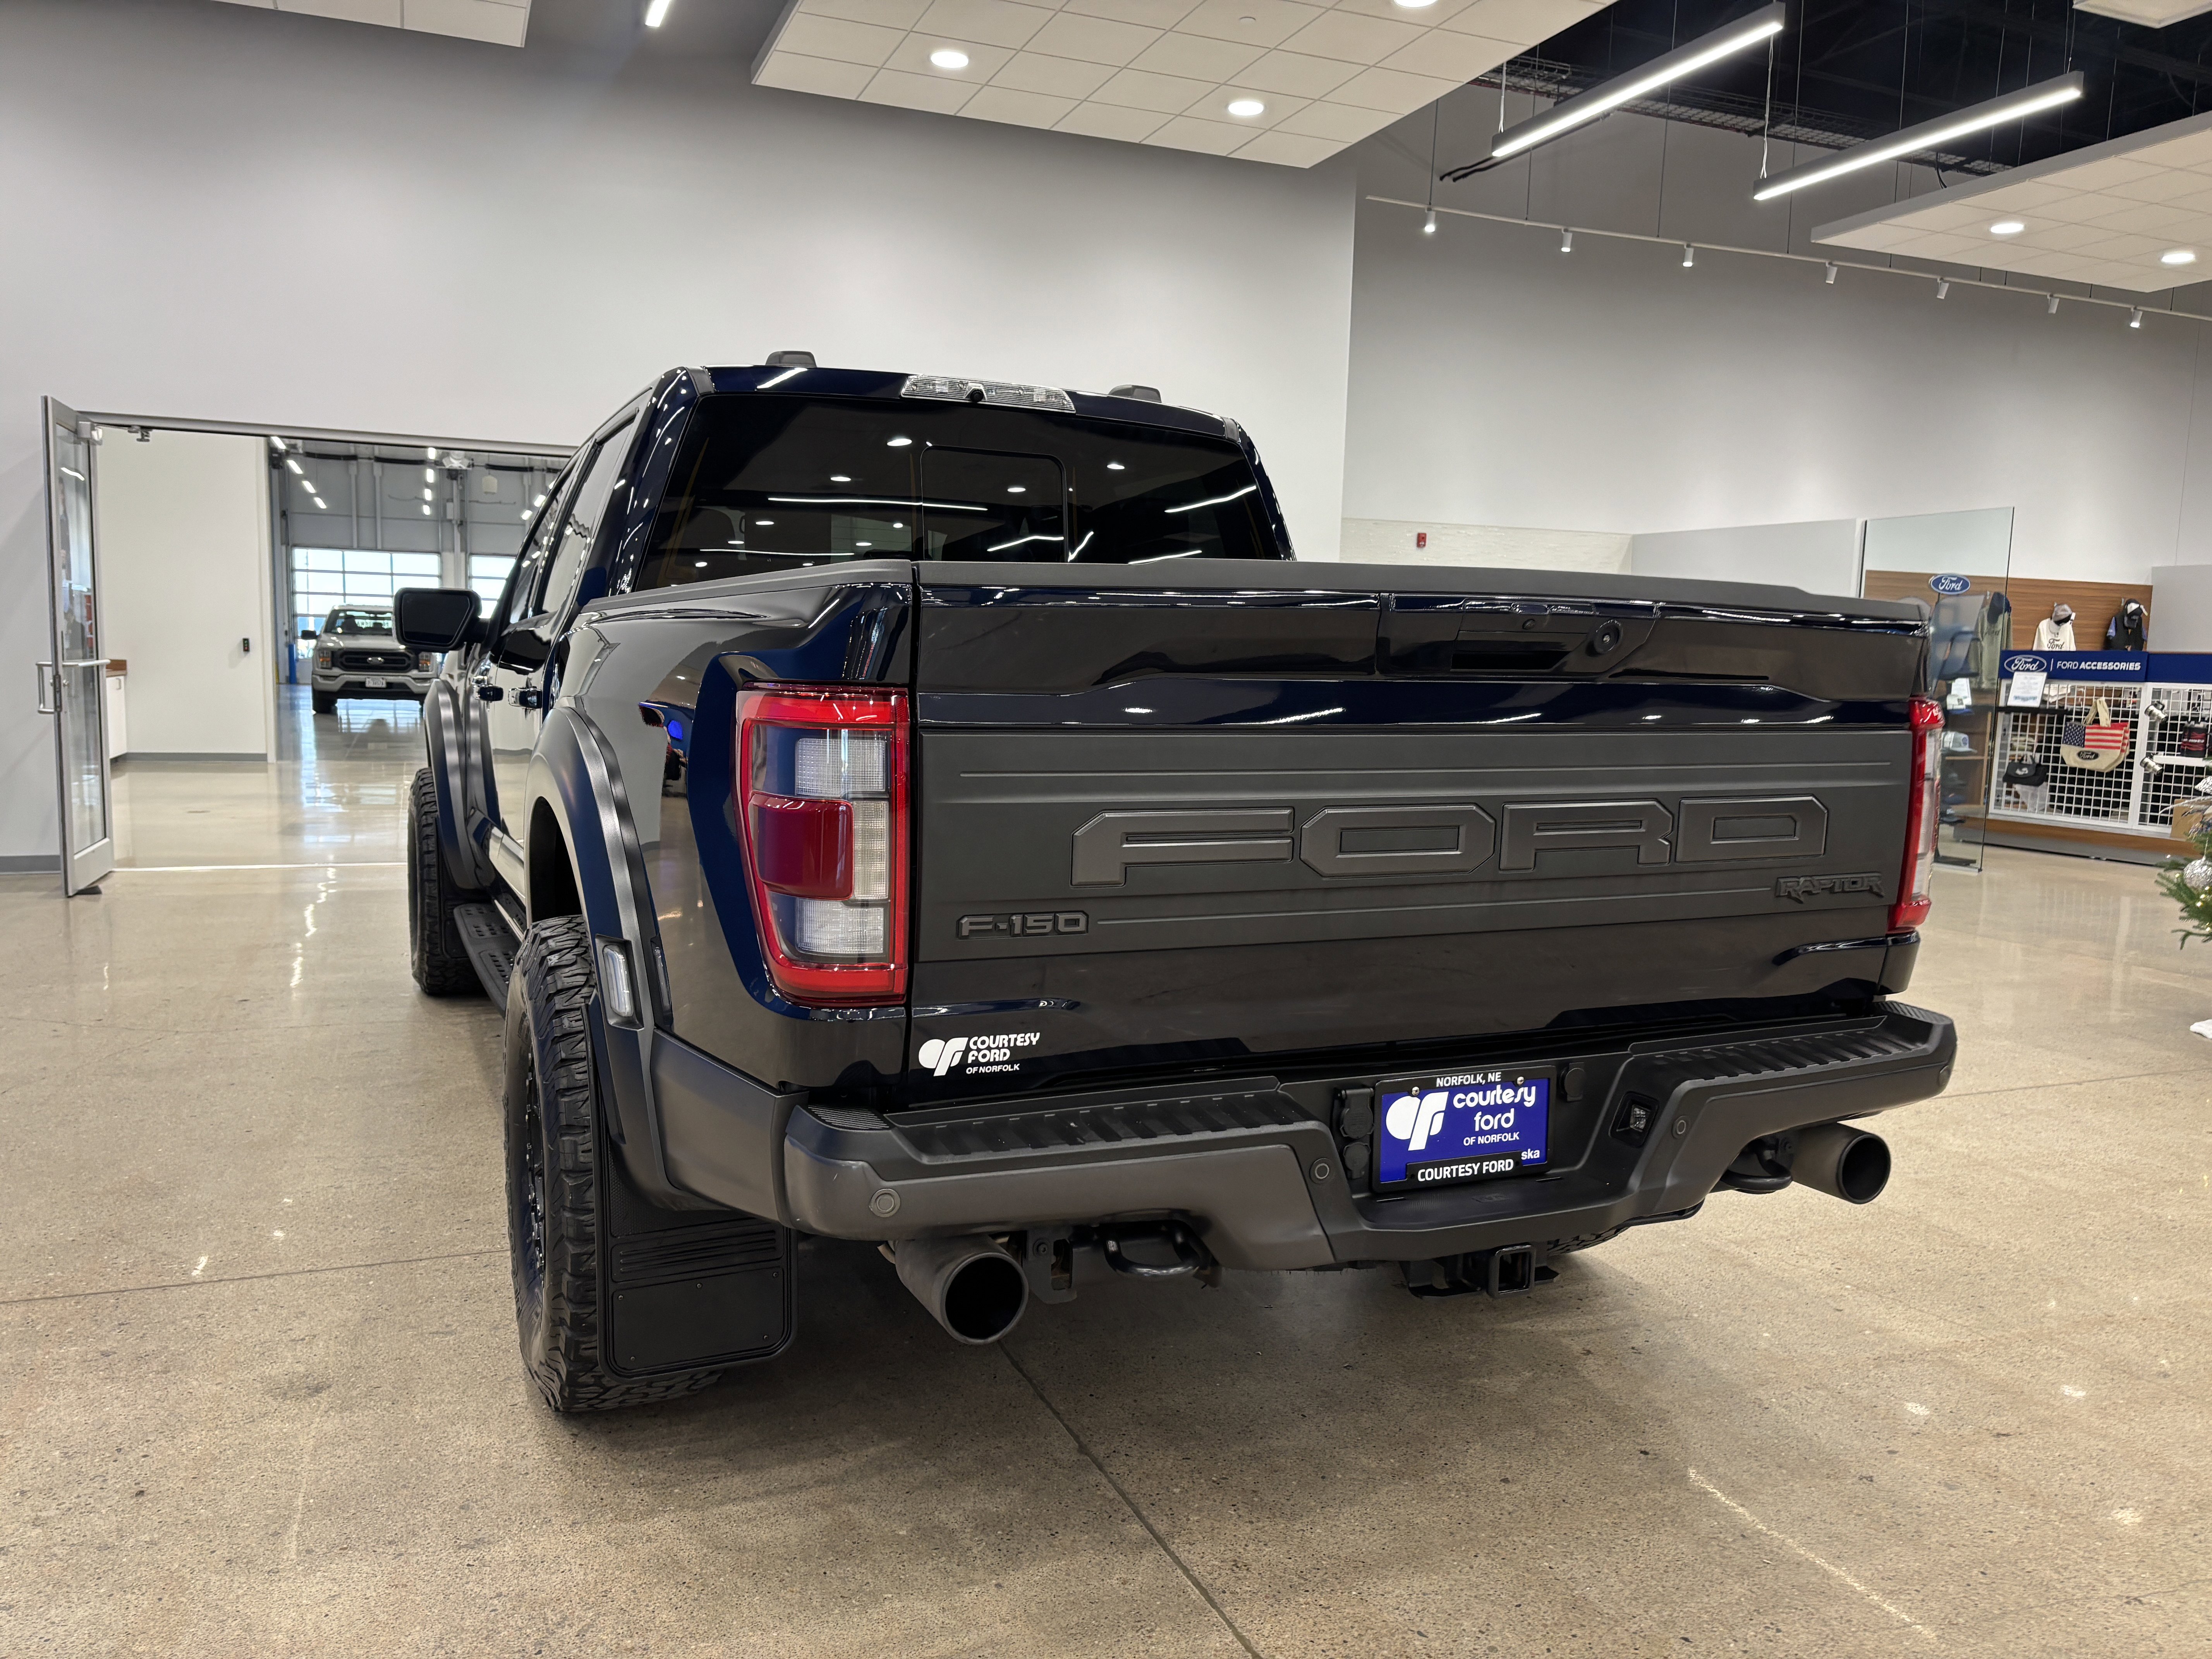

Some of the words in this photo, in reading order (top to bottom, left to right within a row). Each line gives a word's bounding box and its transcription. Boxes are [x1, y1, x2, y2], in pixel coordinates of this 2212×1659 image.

[1939, 576, 1963, 591] Ford
[2047, 638, 2065, 649] Ford
[2011, 657, 2039, 671] Ford
[2057, 661, 2078, 670] FORD
[2079, 661, 2141, 670] ACCESSORIES
[1070, 793, 1829, 888] FORD
[1776, 872, 1885, 903] RAPTOR
[957, 910, 1089, 939] F-150
[969, 1032, 1040, 1050] COURTESY
[968, 1048, 1010, 1063] FORD
[979, 1063, 1020, 1073] NORFOLK
[1436, 1073, 1486, 1087] NORFOLK,
[1487, 1072, 1501, 1082] NE
[1453, 1084, 1536, 1108] courtesy
[1474, 1108, 1515, 1131] ford
[1463, 1136, 1476, 1146] OF
[1478, 1132, 1520, 1144] NORFOLK
[1417, 1162, 1480, 1182] COURTESY
[1482, 1159, 1514, 1174] FORD
